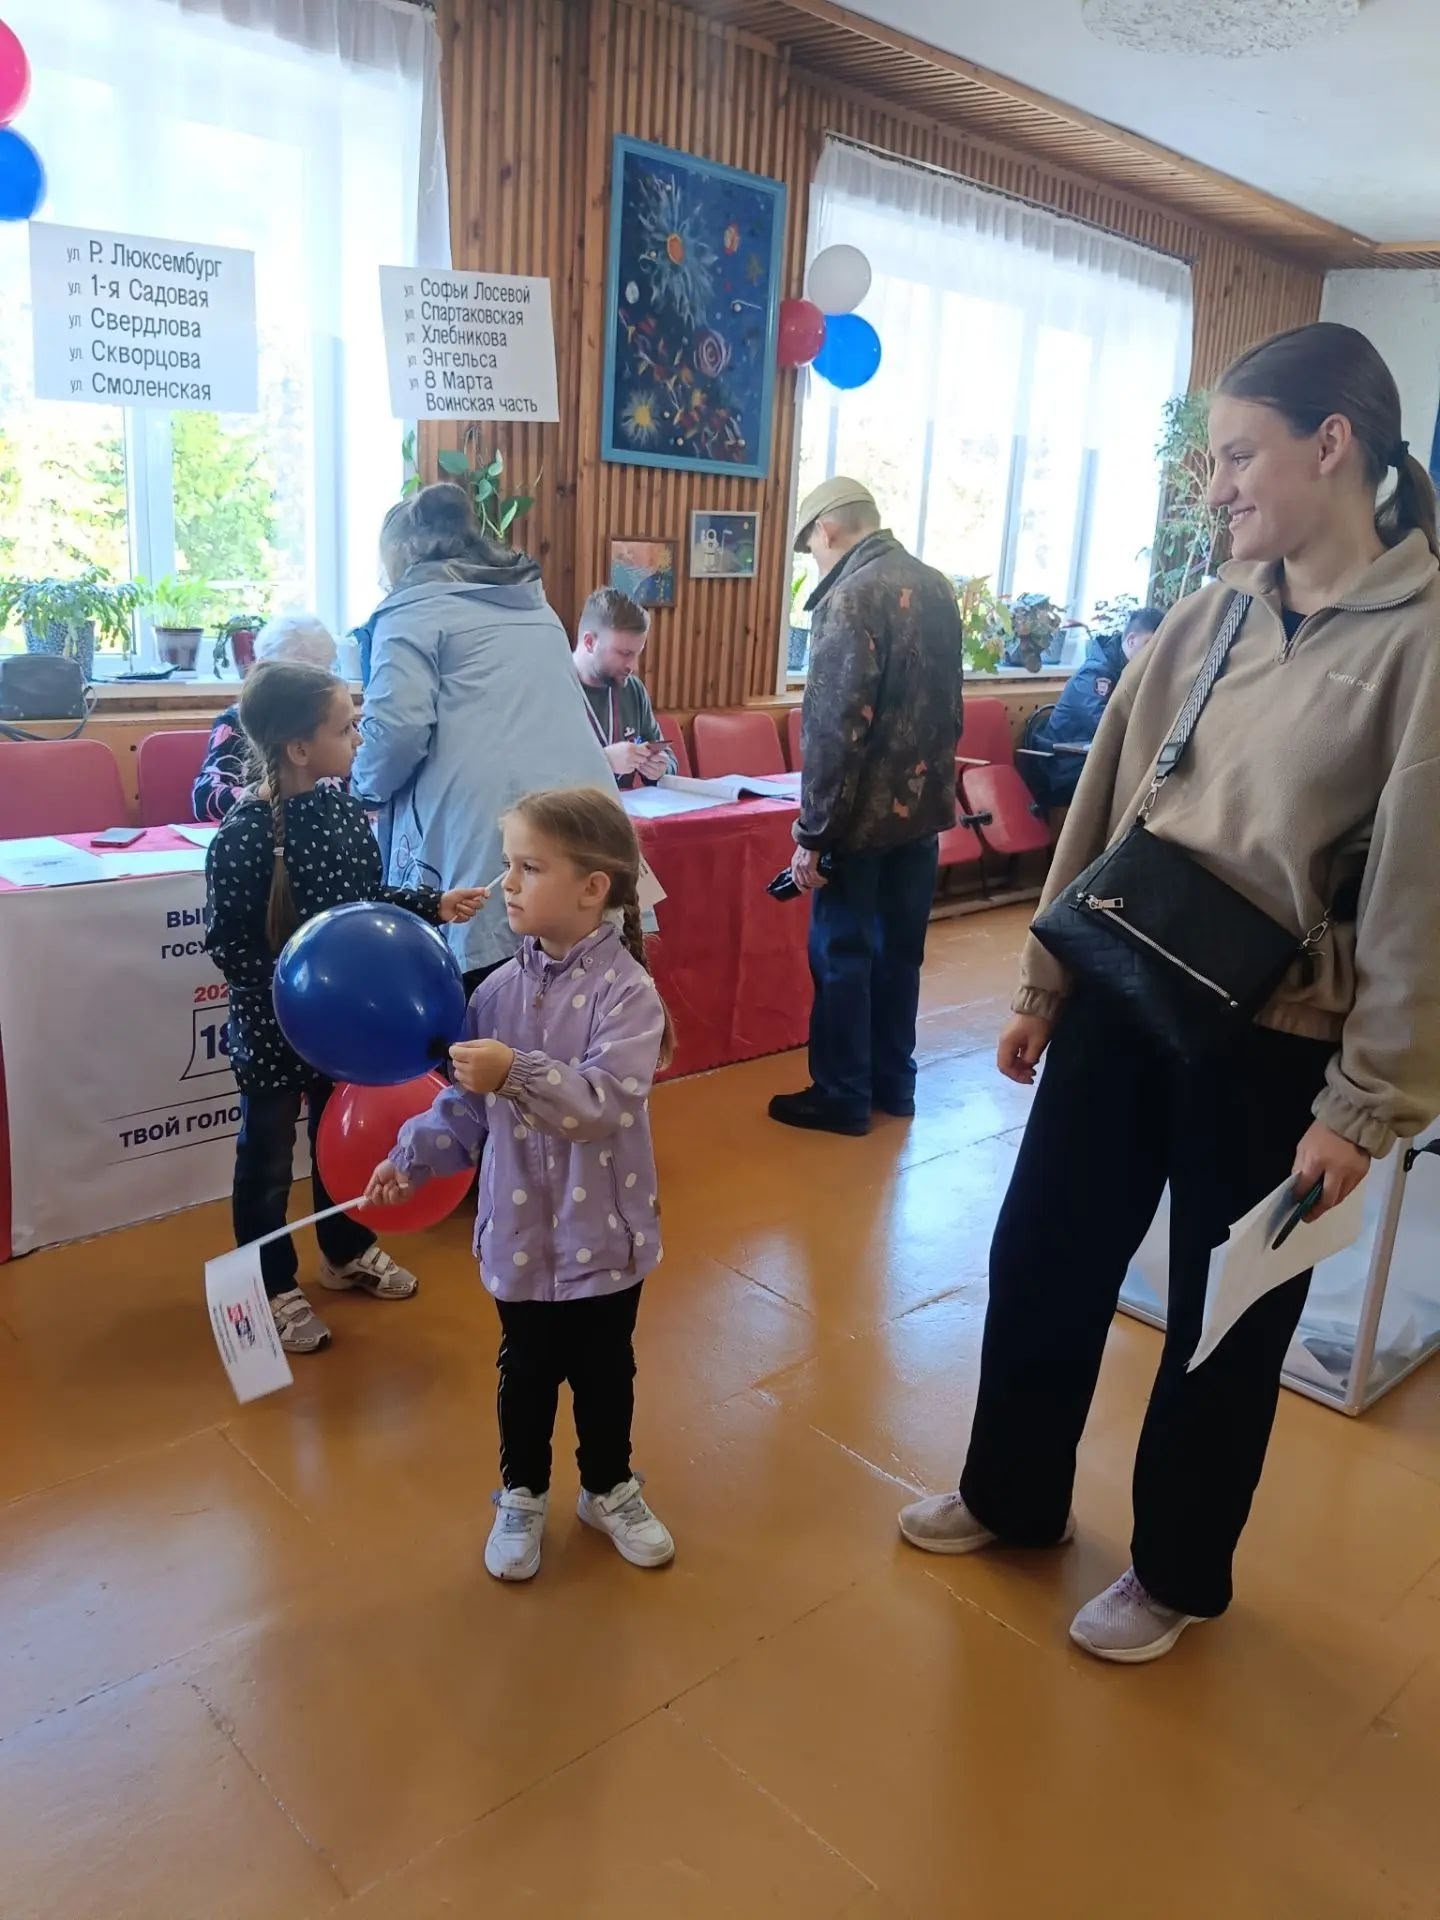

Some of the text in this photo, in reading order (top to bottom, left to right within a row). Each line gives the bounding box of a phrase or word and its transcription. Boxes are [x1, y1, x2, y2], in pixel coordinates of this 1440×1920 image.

[67, 240, 222, 282] ул Р. Люксембург
[68, 274, 209, 308] ул 1-я Садовая
[420, 277, 469, 304] Софьи
[473, 281, 531, 305] Лосевой
[69, 307, 201, 339] ул Свердлова
[421, 301, 524, 326] Спартаковская
[422, 324, 507, 347] Хлебникова
[91, 339, 201, 371] Скворцова
[423, 347, 498, 369] Энгельса
[92, 372, 212, 401] Смоленская
[424, 370, 437, 389] 8
[443, 371, 493, 394] Марта
[426, 392, 538, 413] Воинская часть
[119, 1116, 180, 1148] ТВОЙ
